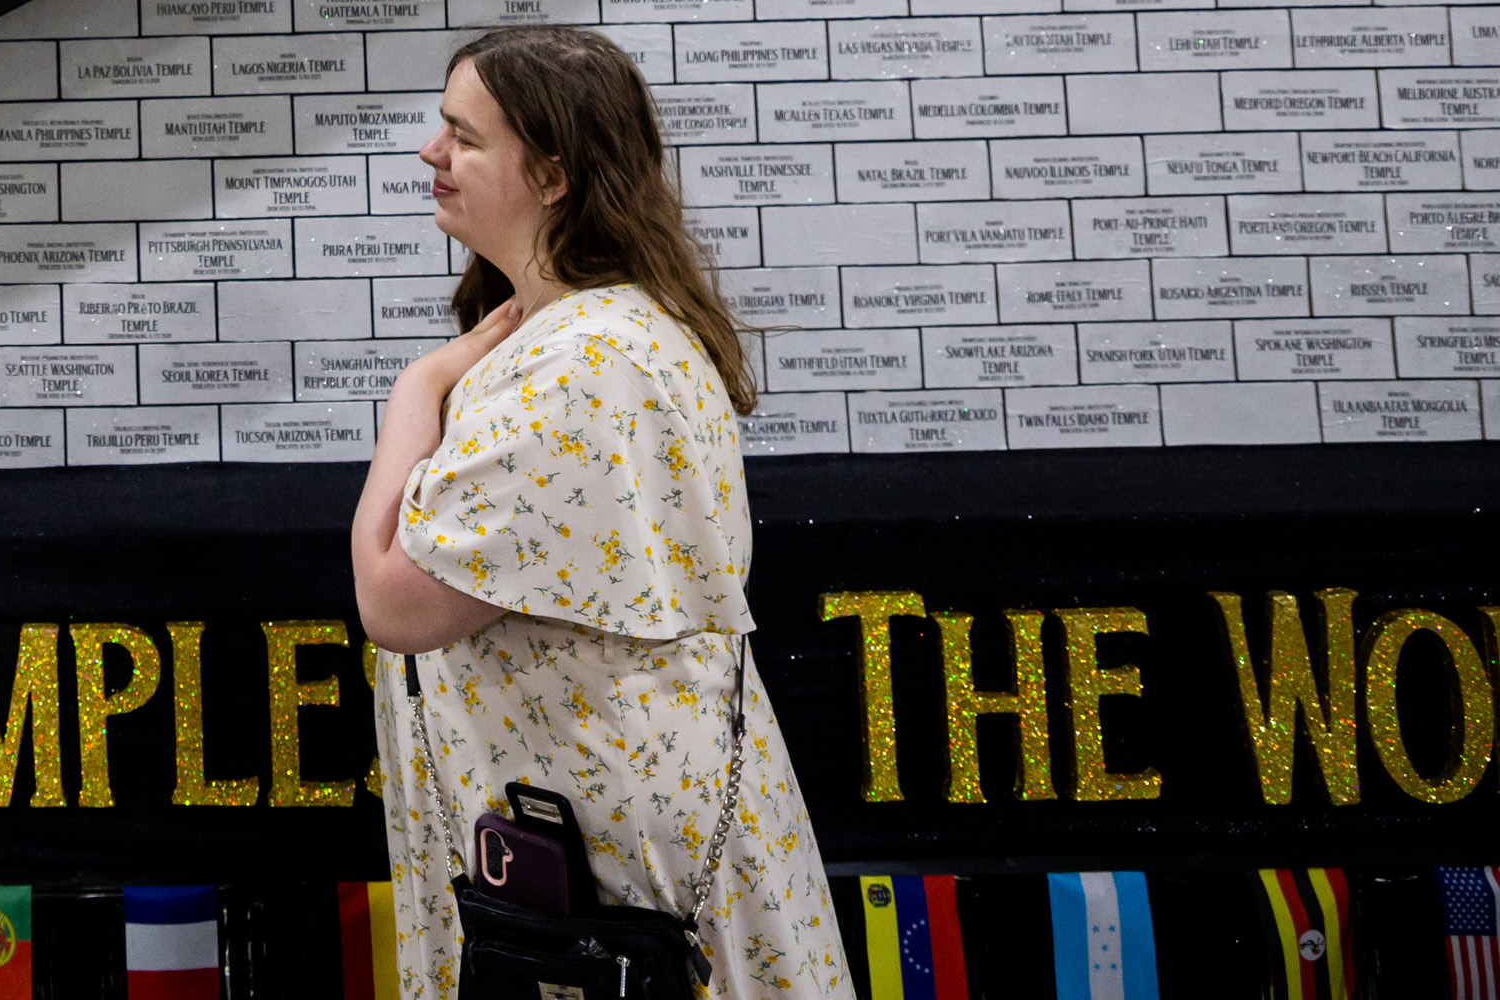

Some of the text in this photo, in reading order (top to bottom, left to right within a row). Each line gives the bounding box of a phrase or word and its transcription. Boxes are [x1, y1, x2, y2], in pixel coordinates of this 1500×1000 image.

[155, 0, 275, 16] HUANCAYO PERU TEMPLE
[318, 3, 420, 18] GUATEMALA TEMPLE
[504, 0, 542, 14] TEMPLE
[719, 48, 779, 62] PHILIPPINES
[780, 47, 818, 61] TEMPLE
[77, 62, 193, 80] LA PAZ BOLIVIA TEMPLE
[231, 59, 346, 76] LAGOS NIGERIA TEMPLE
[314, 111, 426, 127] MAPUTO MOZAMBIQUE
[773, 107, 895, 123] MCALLEN TEXAS TEMPLE
[34, 128, 93, 141] PHILIPPINES
[94, 127, 132, 141] TEMPLE
[164, 120, 266, 136] MANTI UTAH TEMPLE
[352, 127, 390, 141] TEMPLE
[1392, 150, 1458, 163] CALIFORNIA
[700, 163, 812, 178] NASHVILLE TENNESSEE
[1363, 165, 1402, 179] TEMPLE
[224, 174, 357, 190] MOUNT TIMPANOGOS UTAH
[381, 181, 410, 195] NAGA
[738, 179, 776, 193] TEMPLE
[273, 191, 310, 205] TEMPLE
[147, 238, 284, 253] PITTSBURGH PENNSYLVANIA
[322, 242, 421, 257] PIURA PERU TEMPLE
[41, 250, 86, 263] ARIZONA
[88, 249, 126, 262] TEMPLE
[197, 254, 235, 268] TEMPLE
[10, 310, 48, 324] TEMPLE
[381, 305, 435, 319] RICHMOND
[1008, 344, 1054, 358] ARIZONA
[1305, 337, 1373, 351] WASHINGTON
[320, 357, 373, 371] SHANGHAI
[838, 356, 868, 369] UTAH
[869, 354, 908, 369] TEMPLE
[1295, 353, 1335, 367] TEMPLE
[5, 363, 115, 377] SEATTLE WASHINGTON
[982, 360, 1020, 375] TEMPLE
[161, 368, 270, 383] SEOUL KOREA TEMPLE
[352, 375, 367, 389] OF
[41, 378, 80, 392] TEMPLE
[1044, 414, 1076, 427] FALLS
[1075, 413, 1110, 426] IDAHO
[1110, 411, 1149, 425] TEMPLE
[86, 432, 200, 448] TRUJILLO PERU TEMPLE
[235, 428, 362, 444] TUCSON ARIZONA TEMPLE
[818, 590, 1162, 803] THE
[1207, 587, 1500, 806] WO
